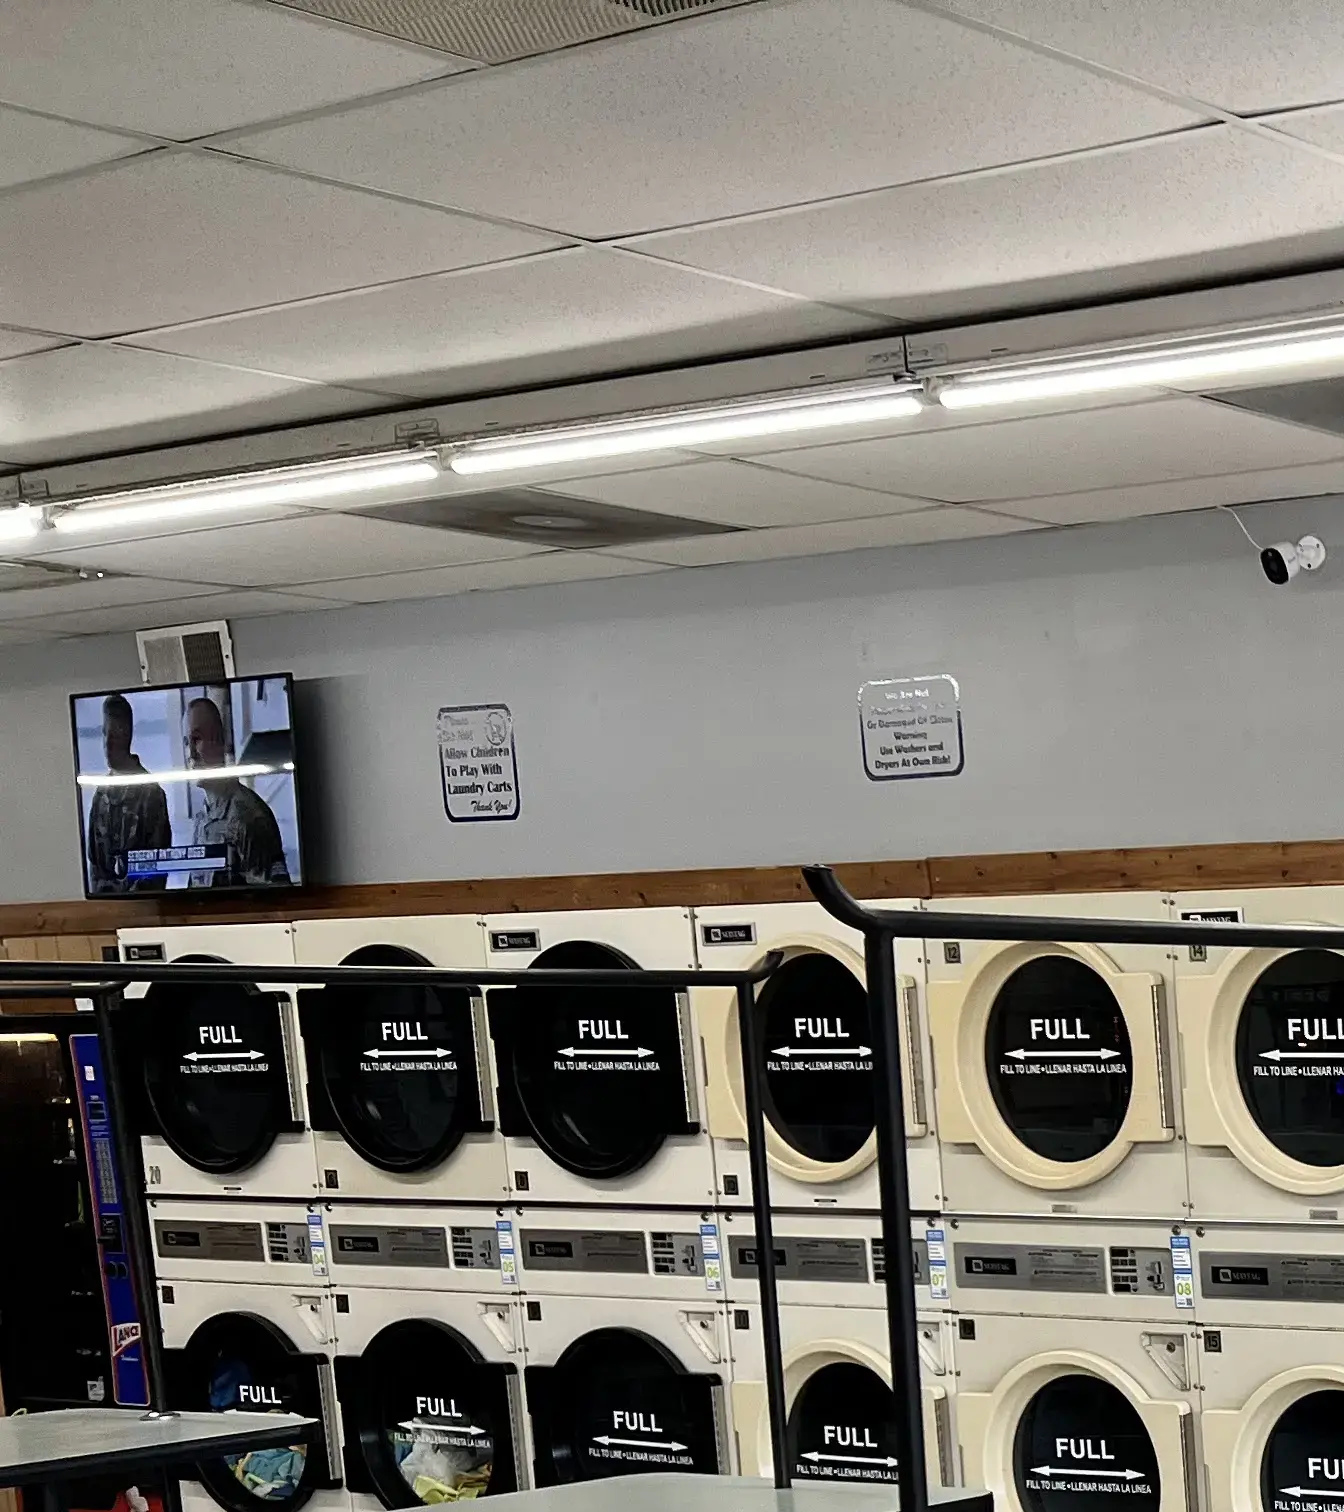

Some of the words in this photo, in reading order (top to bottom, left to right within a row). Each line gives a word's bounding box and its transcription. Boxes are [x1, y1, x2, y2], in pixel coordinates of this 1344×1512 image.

[446, 766, 458, 777] To
[460, 765, 479, 779] Play
[481, 763, 502, 775] With
[447, 782, 484, 796] Laundry
[487, 781, 512, 793] Carts
[200, 1026, 242, 1044] FULL
[382, 1022, 428, 1040] FULL
[579, 1020, 628, 1039] FULL
[795, 1018, 849, 1037] FULL
[1031, 1019, 1090, 1039] FULL
[932, 1273, 945, 1287] 07
[1177, 1282, 1192, 1296] 08
[239, 1385, 281, 1404] FULL
[417, 1397, 462, 1418] FULL
[614, 1411, 662, 1432] FULL
[824, 1426, 877, 1447] FULL
[1056, 1438, 1114, 1459] FULL
